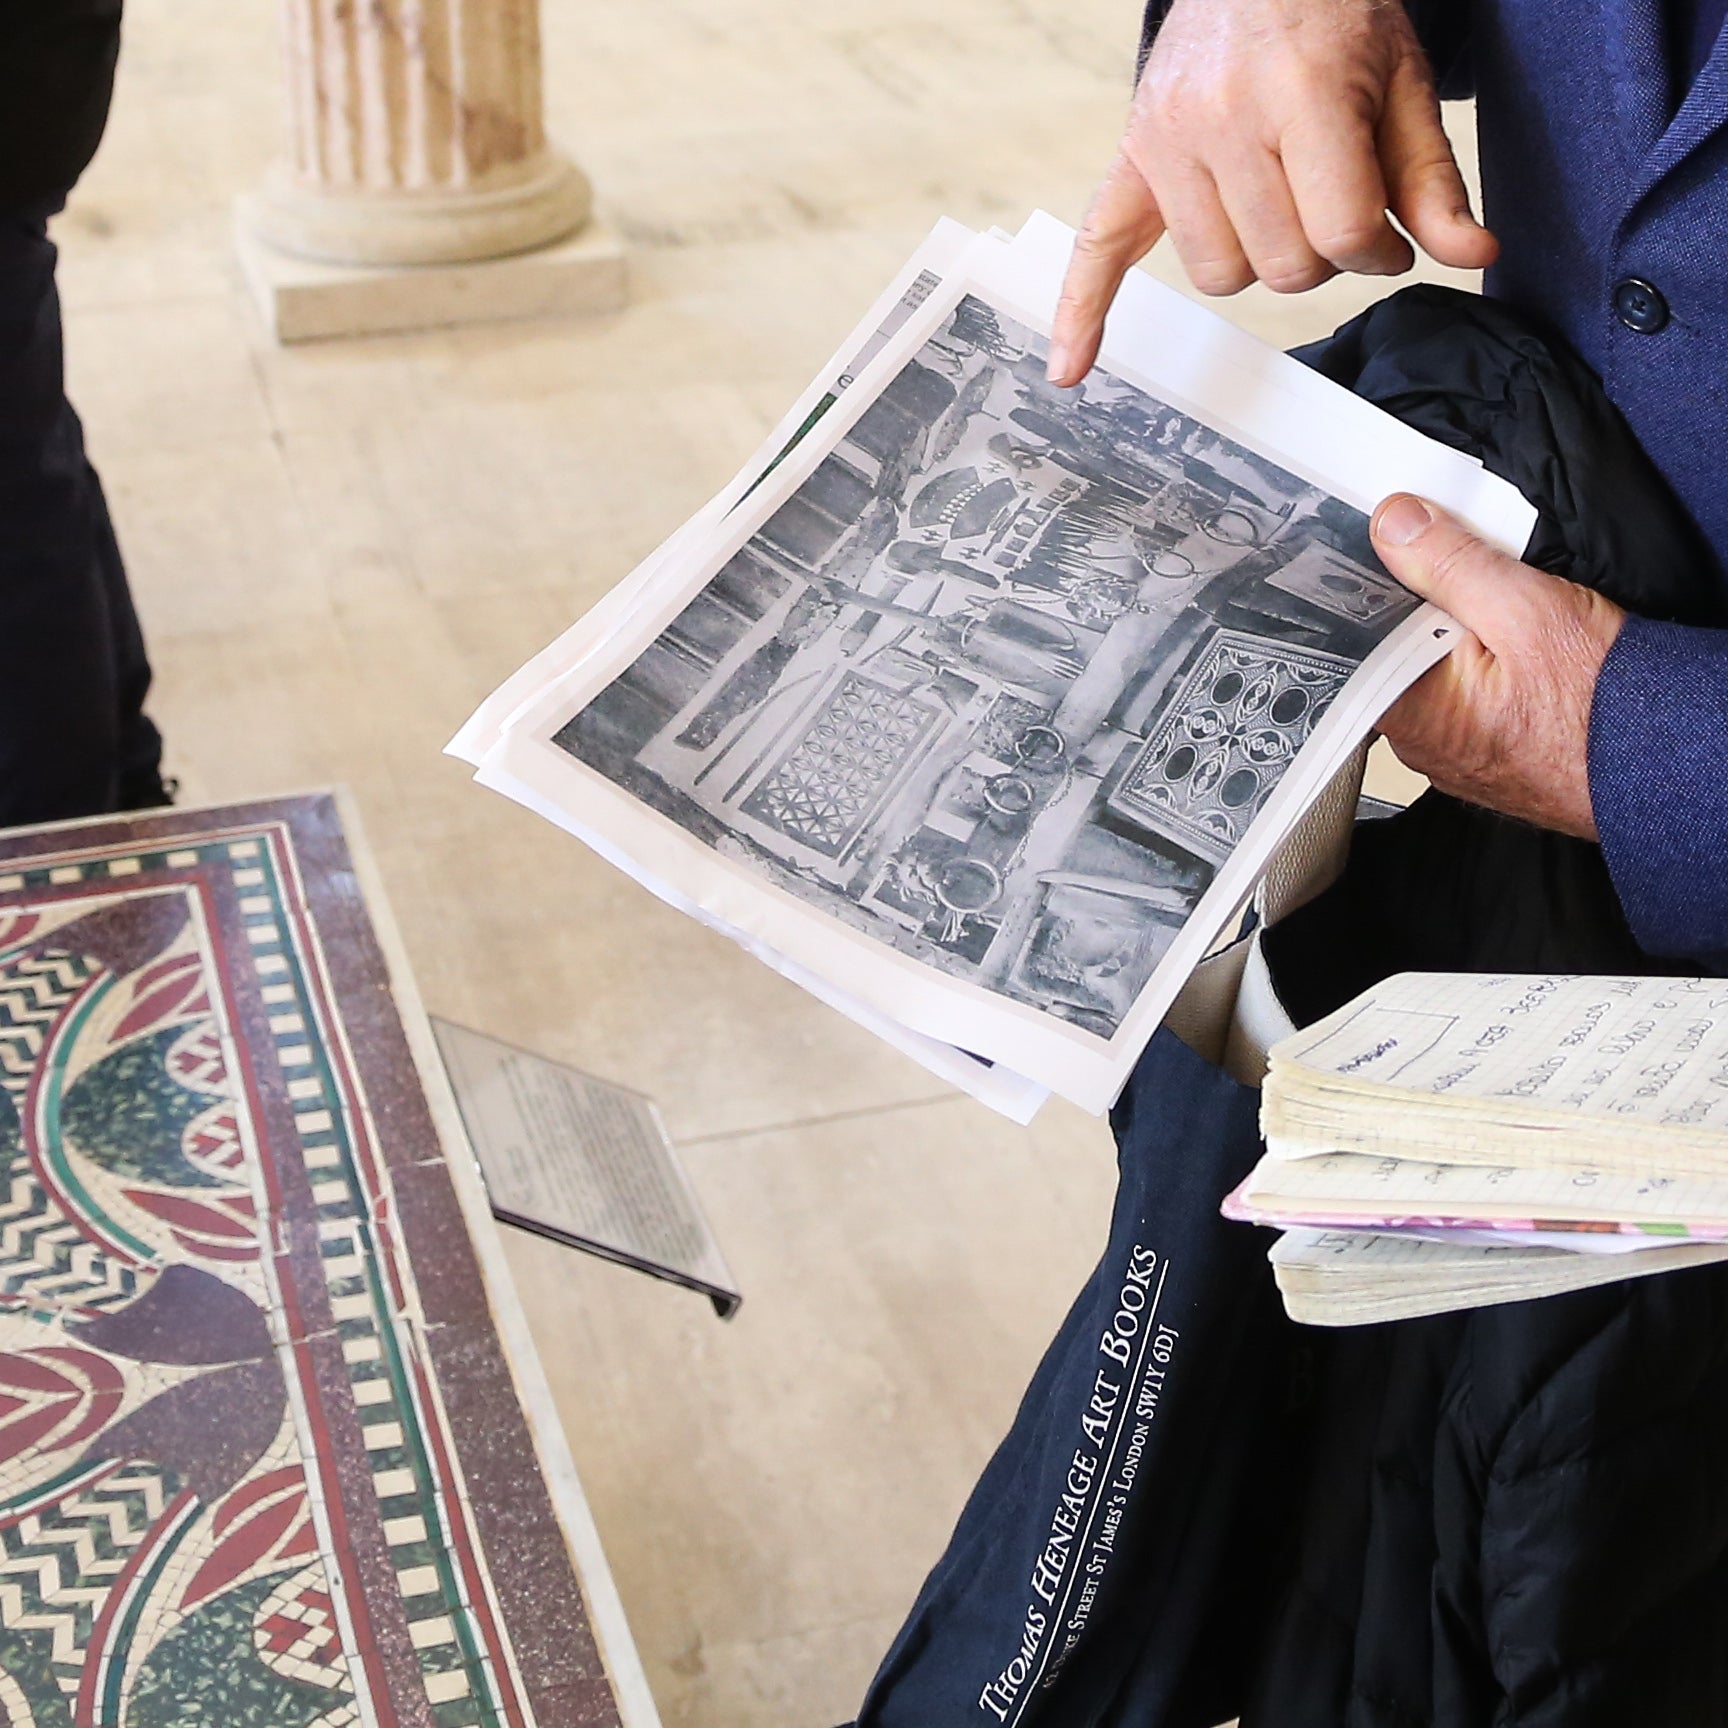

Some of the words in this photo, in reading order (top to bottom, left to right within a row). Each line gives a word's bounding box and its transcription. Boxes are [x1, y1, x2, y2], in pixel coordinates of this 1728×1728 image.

[1099, 1244, 1157, 1369] BOOKS
[1081, 1369, 1121, 1450] ART
[1030, 1448, 1098, 1607] HENEAGE
[1067, 1577, 1100, 1630] STREET
[1112, 1422, 1150, 1492] LONDON
[1152, 1323, 1180, 1364] 6DJ
[978, 1604, 1047, 1723] THOMAS
